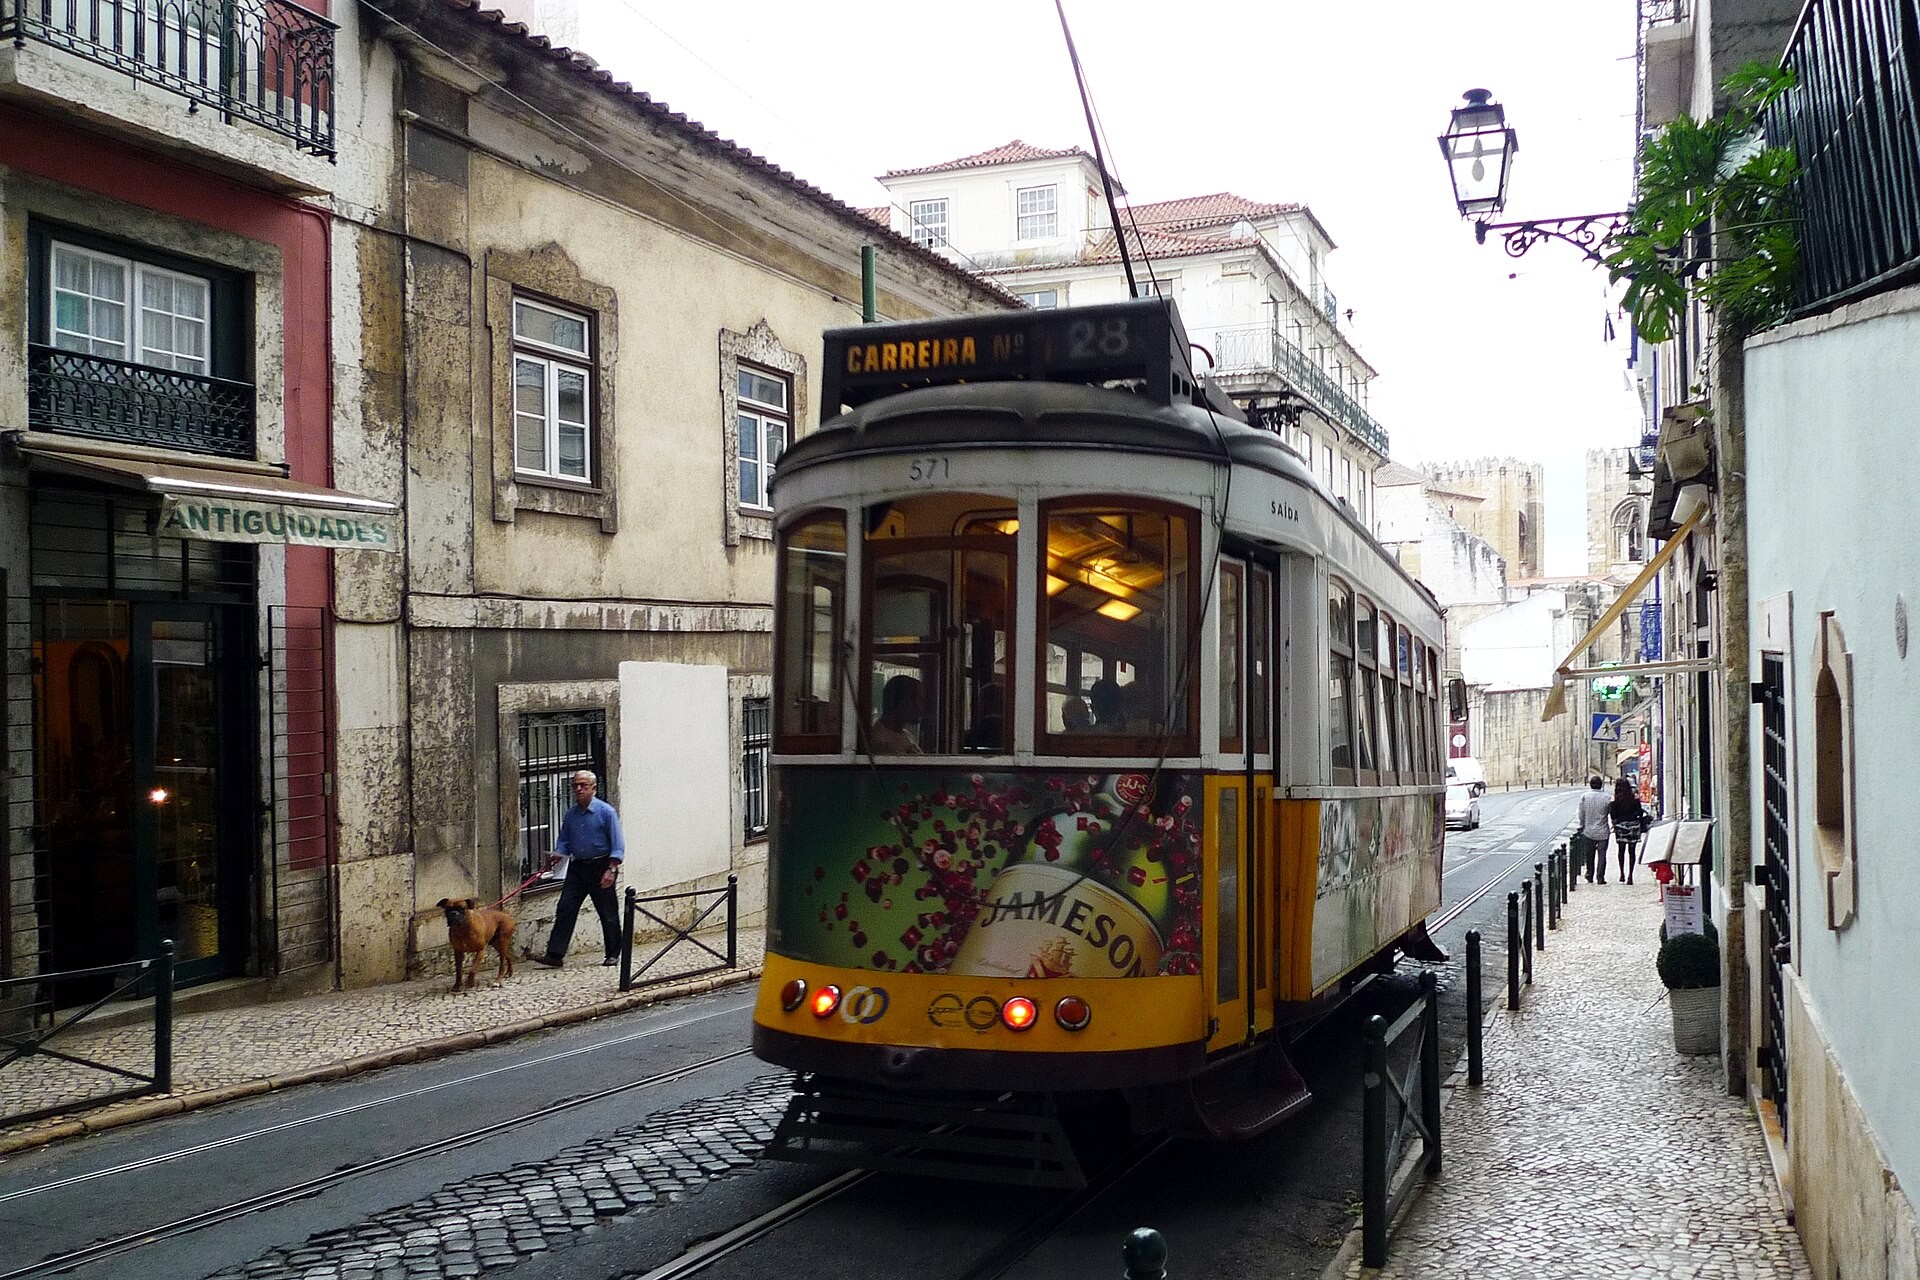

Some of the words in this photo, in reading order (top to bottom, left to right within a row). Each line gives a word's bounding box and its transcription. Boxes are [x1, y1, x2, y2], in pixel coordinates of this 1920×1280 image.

[847, 336, 977, 374] CARREIRA
[1068, 318, 1129, 358] 28
[909, 457, 950, 481] 571
[165, 504, 388, 544] ANTIGUIDADES
